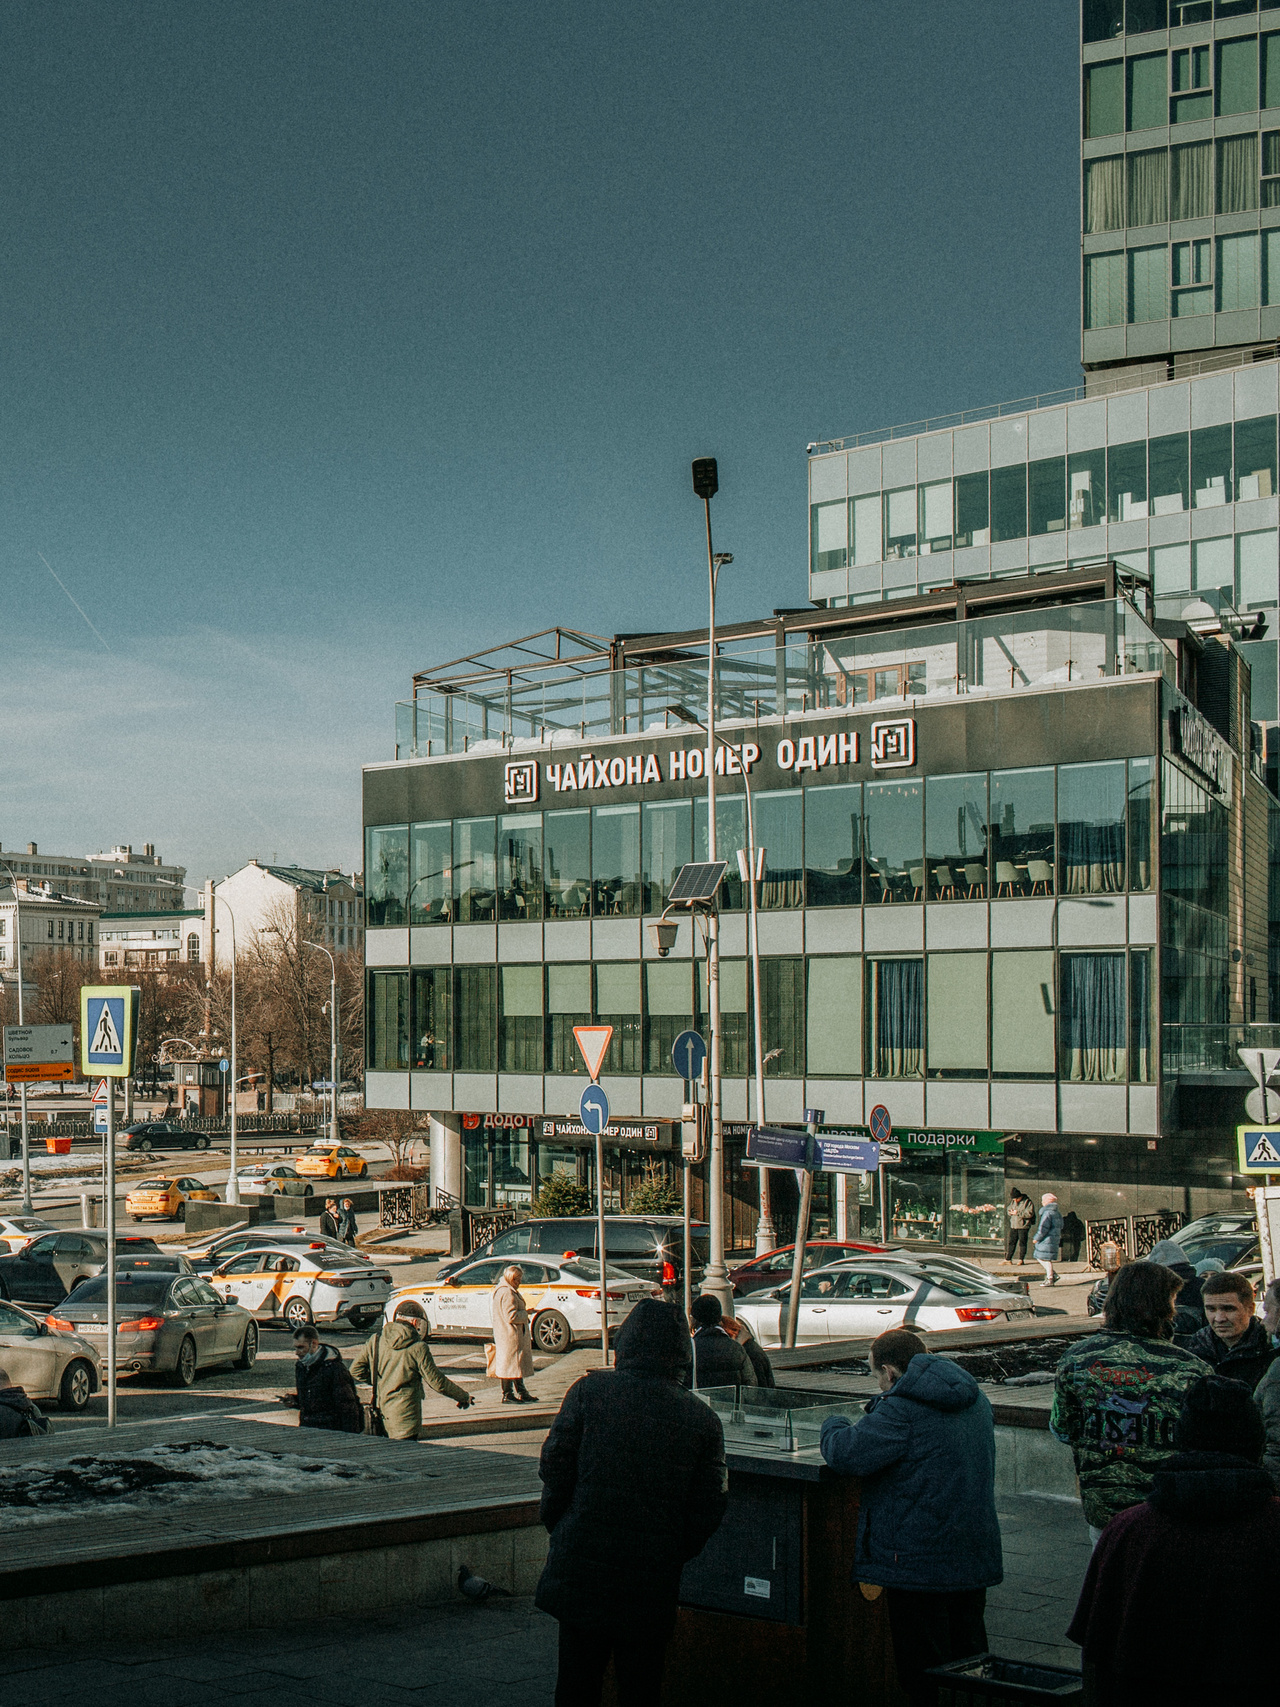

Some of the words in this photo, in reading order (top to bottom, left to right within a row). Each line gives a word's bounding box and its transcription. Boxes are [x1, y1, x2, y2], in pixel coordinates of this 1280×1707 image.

[546, 753, 662, 793] ЧАЙХОНА
[669, 742, 761, 780] НОМЕР
[777, 731, 860, 772] ОДИН
[483, 1113, 525, 1128] ДОДО
[620, 1126, 644, 1138] ОДИН
[907, 1132, 975, 1148] подарки
